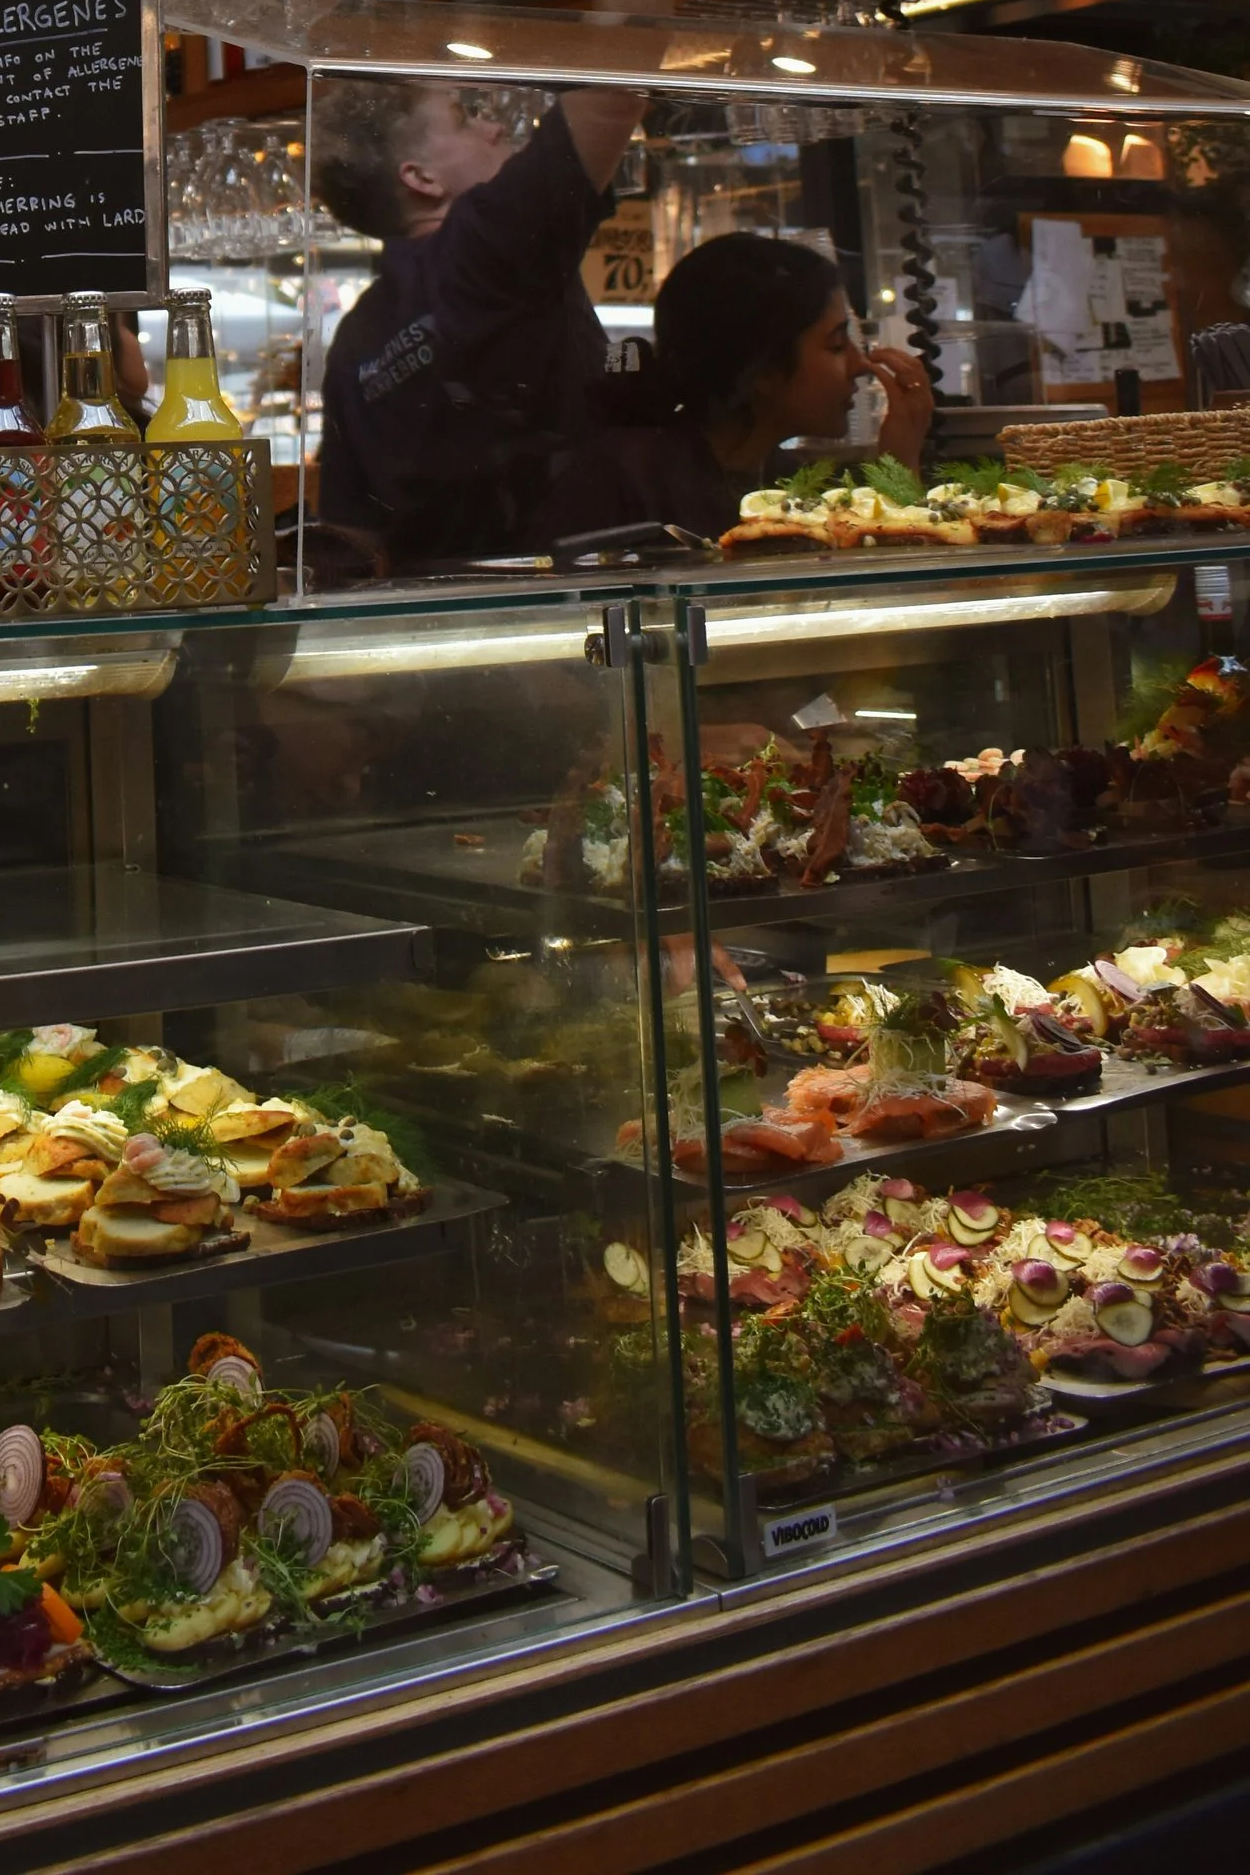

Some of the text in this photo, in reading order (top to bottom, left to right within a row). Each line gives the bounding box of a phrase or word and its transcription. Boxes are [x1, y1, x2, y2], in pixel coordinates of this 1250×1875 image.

[34, 49, 56, 63] ON
[69, 41, 103, 58] THE
[32, 67, 52, 82] OF
[5, 85, 71, 104] CONTACT
[87, 75, 124, 93] THE
[90, 192, 105, 204] IS
[44, 216, 91, 232] WITH
[102, 208, 145, 228] LARD
[770, 1515, 830, 1547] VIBOCOLD
